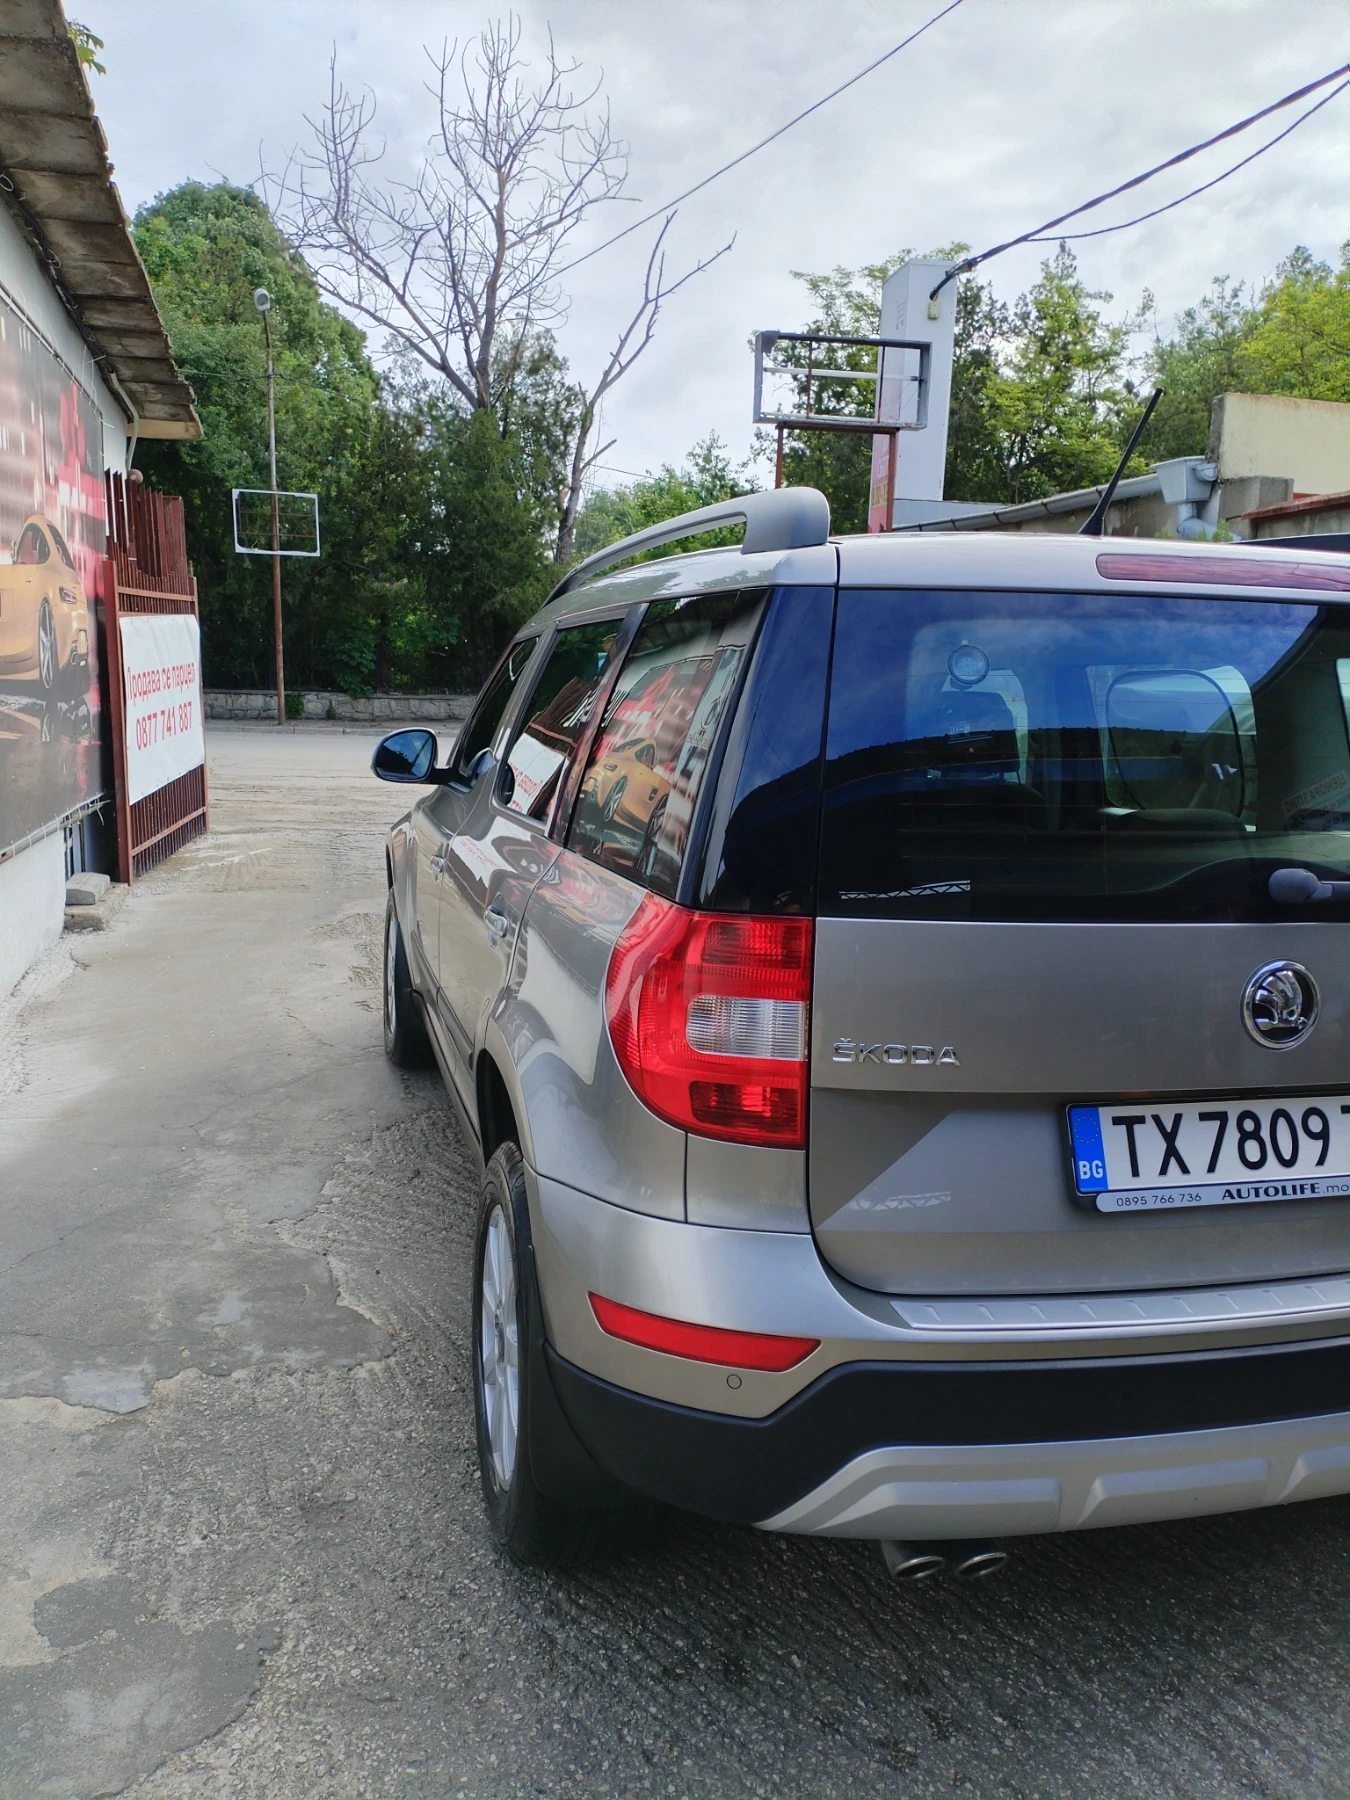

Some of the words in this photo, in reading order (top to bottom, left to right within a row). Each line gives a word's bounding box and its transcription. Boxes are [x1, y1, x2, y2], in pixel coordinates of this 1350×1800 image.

[127, 666, 161, 707] Продава
[161, 667, 171, 690] се
[171, 662, 196, 694] парцел
[135, 712, 158, 751] 0877
[160, 706, 177, 740] 741
[178, 701, 193, 733] 887
[832, 1037, 960, 1067] ŠKODA
[1078, 1160, 1104, 1180] BG
[1116, 1195, 1147, 1207] 0895
[1152, 1193, 1175, 1205] 766
[1179, 1192, 1202, 1204] 736
